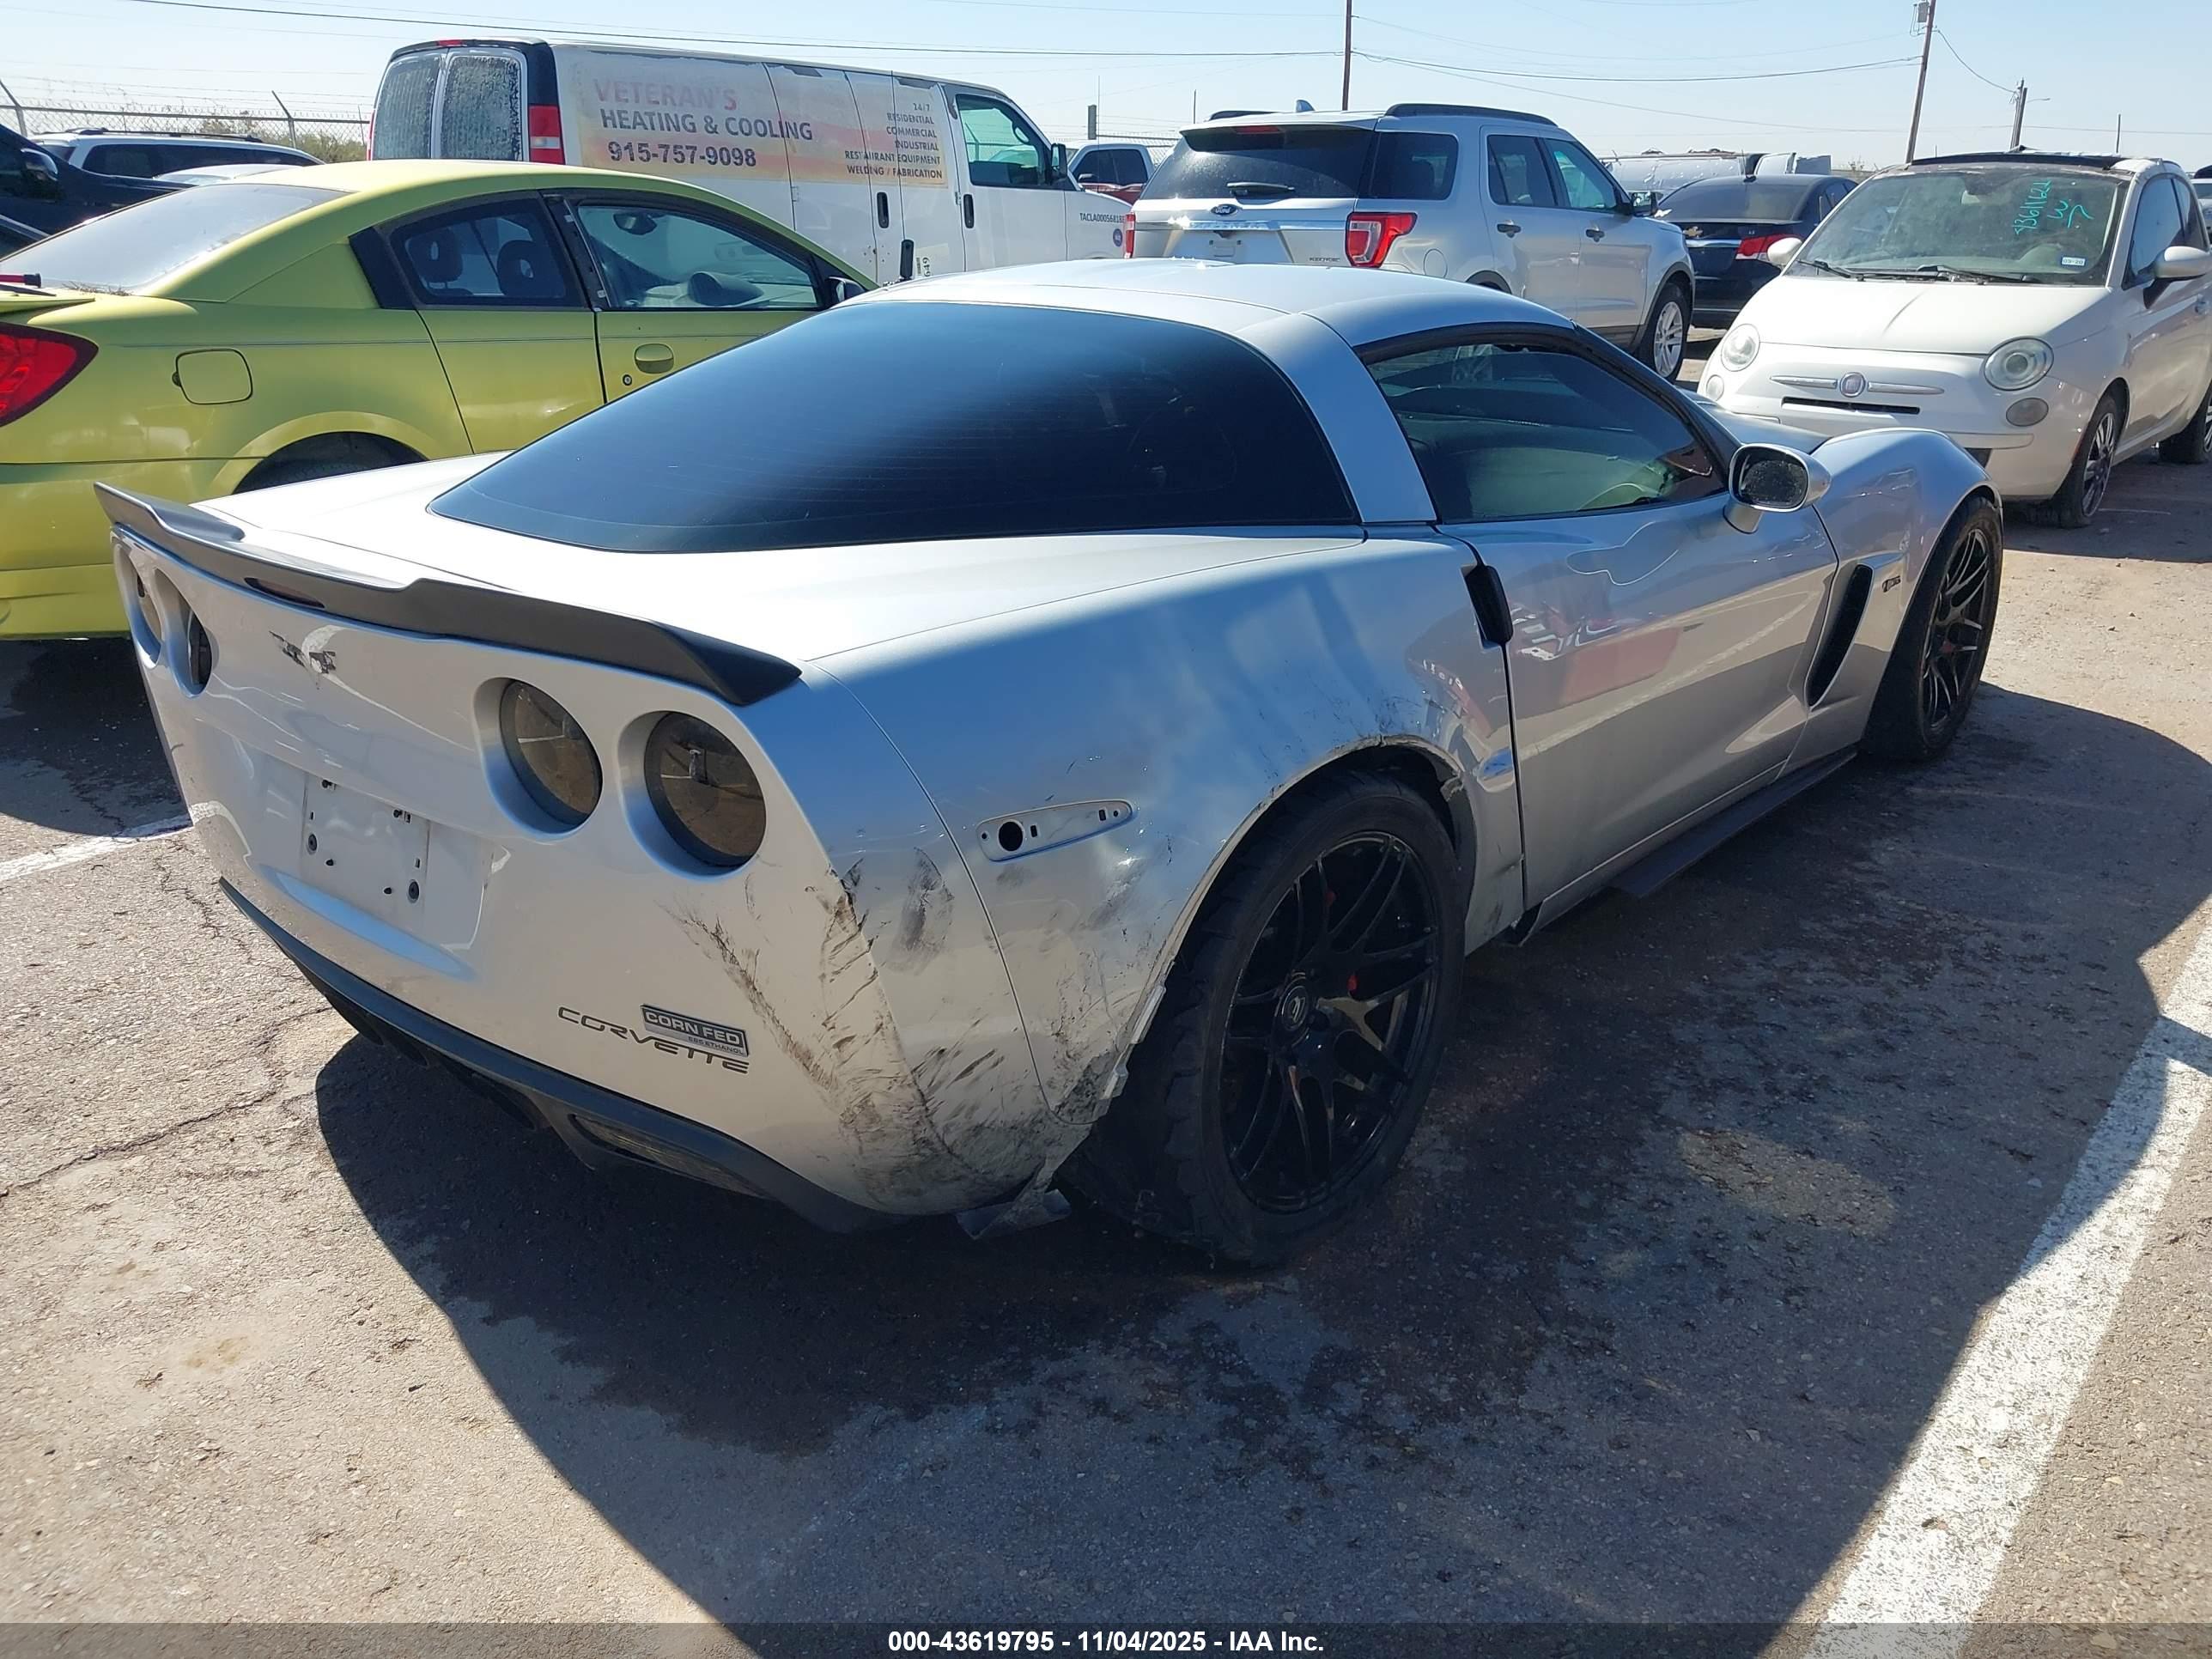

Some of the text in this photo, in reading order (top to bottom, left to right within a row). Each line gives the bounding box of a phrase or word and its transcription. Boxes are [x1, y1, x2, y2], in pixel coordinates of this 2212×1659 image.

[594, 79, 738, 111] VETERAN'S
[600, 108, 813, 141] HEATING & COOLING
[887, 112, 935, 125] RESIDENTIAL
[886, 126, 938, 138] COMMERCIAL
[895, 140, 939, 151] INDUSTRIAL
[608, 141, 757, 167] 915-757-9098
[844, 150, 941, 165] RESTAURANT EQUIPMENT
[847, 165, 885, 176] WELDING
[892, 167, 943, 179] FABRICATION
[645, 1012, 740, 1045] CORN FED
[558, 1006, 750, 1074] CORVETTE
[704, 1042, 744, 1055] ETHANOL
